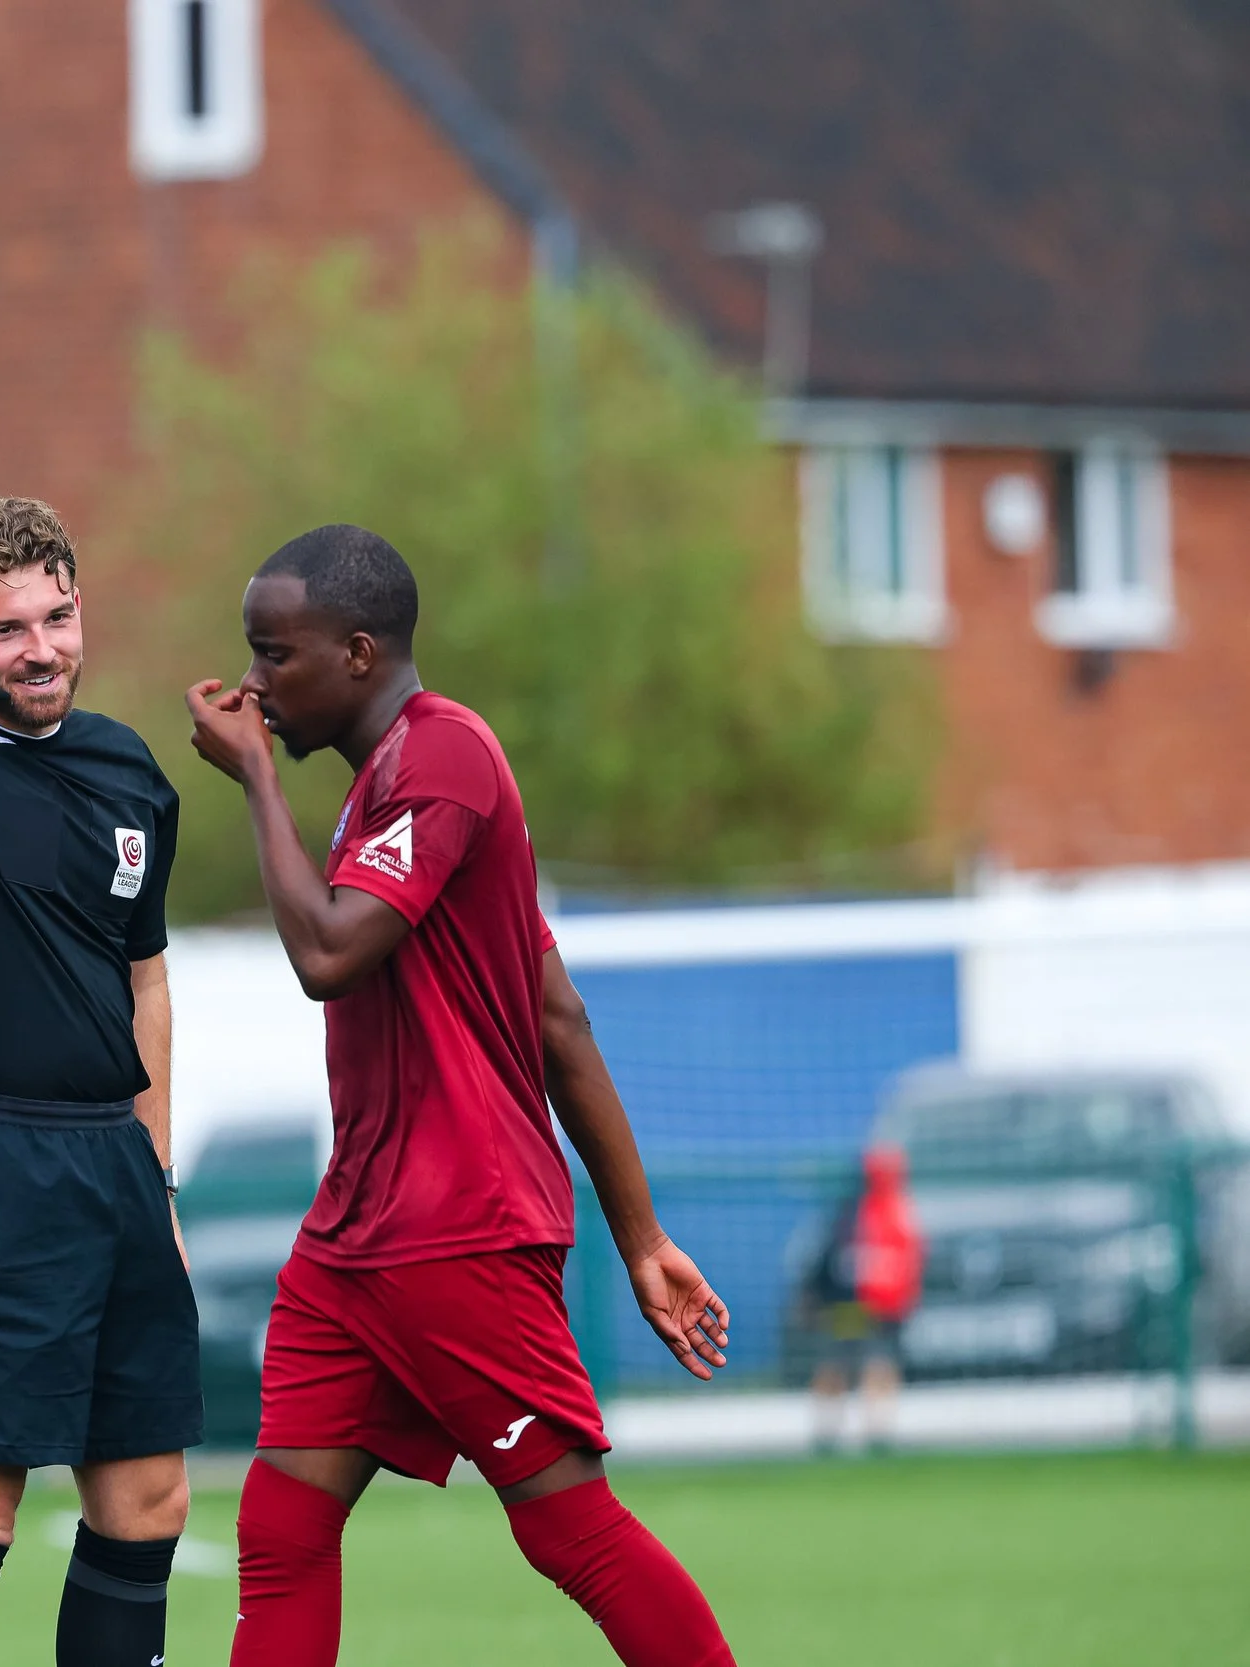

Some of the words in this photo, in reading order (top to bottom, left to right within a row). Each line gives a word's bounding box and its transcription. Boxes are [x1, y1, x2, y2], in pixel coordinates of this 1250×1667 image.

[380, 853, 412, 875] MELLOR
[116, 871, 141, 882] NATIONAL
[117, 879, 138, 889] LEAGUE
